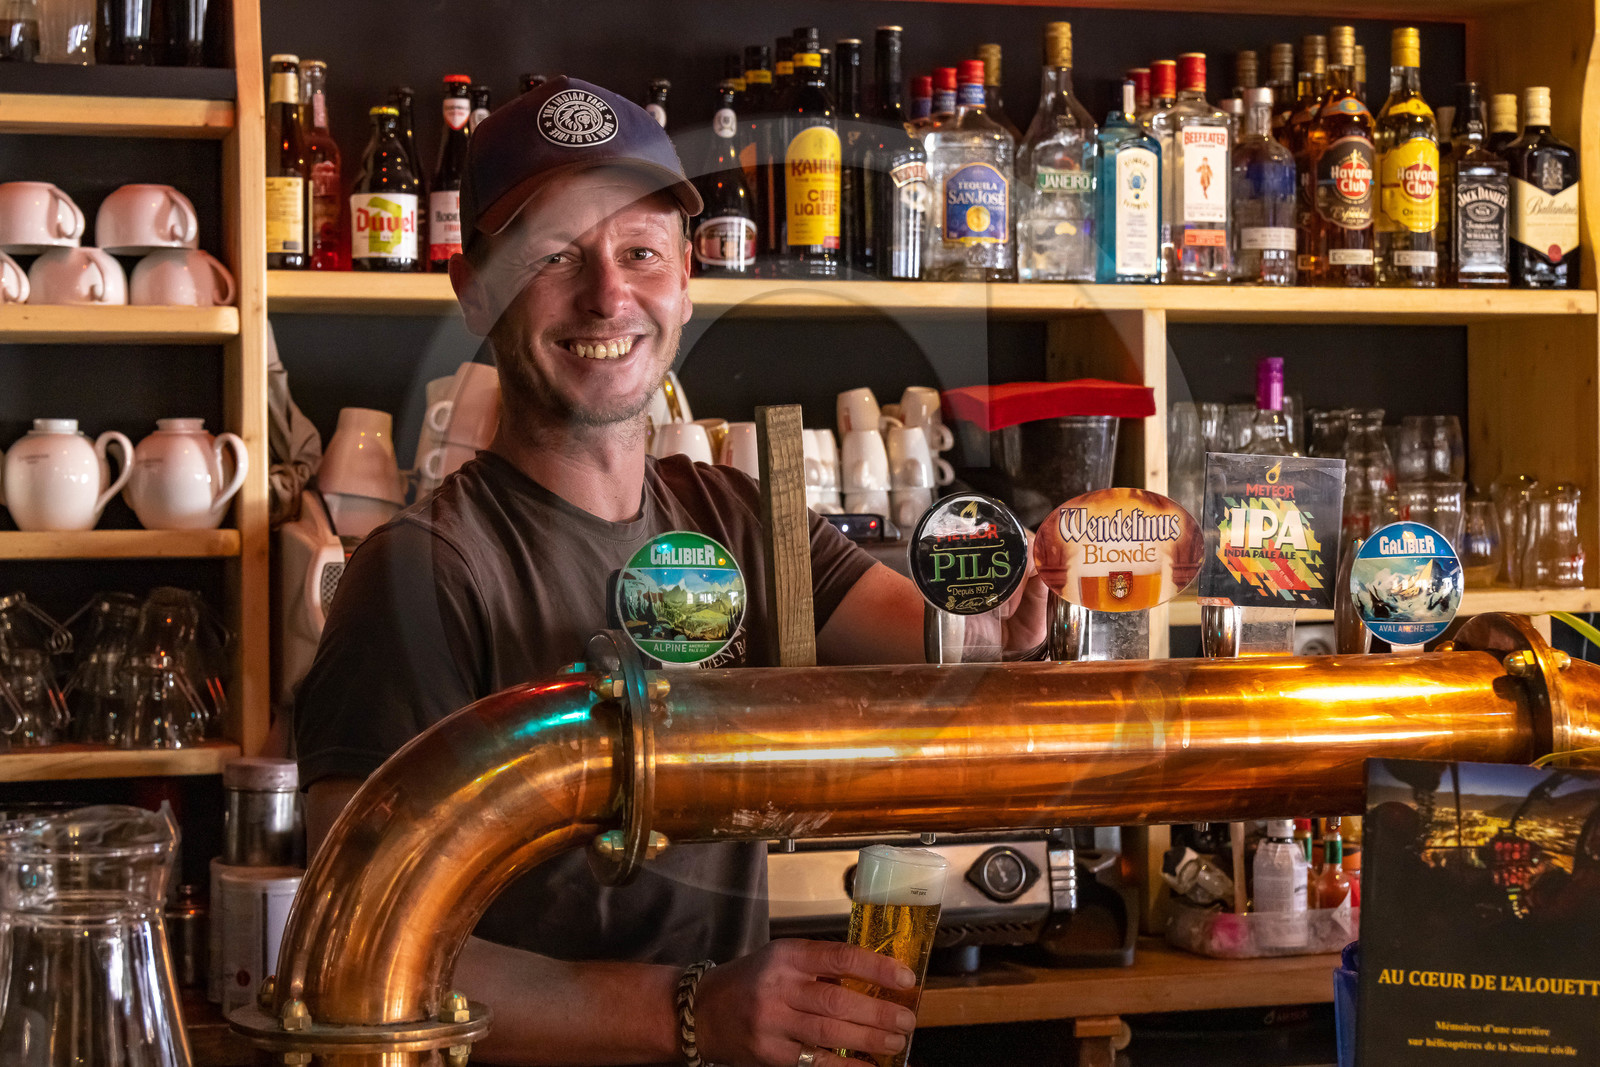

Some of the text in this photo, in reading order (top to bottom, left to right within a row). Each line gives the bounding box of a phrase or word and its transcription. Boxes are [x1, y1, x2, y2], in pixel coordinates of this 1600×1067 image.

[543, 92, 608, 118] THE INDIAN FACE
[548, 121, 615, 143] BORN TO BE FREE
[1184, 131, 1226, 146] BEEFEATER
[958, 181, 998, 190] TEQUILA
[1040, 173, 1090, 190] JANEIRO
[1340, 179, 1367, 193] Club
[1406, 181, 1432, 195] Club
[1457, 190, 1478, 208] JACK
[357, 207, 414, 233] Duvel
[1246, 483, 1295, 499] METEOR
[1059, 507, 1182, 544] Wendelinus
[1230, 508, 1309, 551] IPA
[1379, 534, 1436, 555] GALIBIER
[650, 543, 716, 566] GALIBIER
[1224, 549, 1297, 560] INDIA PALE ALE
[929, 550, 1011, 582] PILS
[952, 586, 989, 598] Depuis 1927
[1379, 624, 1425, 633] AVALANCHE
[653, 642, 688, 653] ALPINE
[1378, 968, 1405, 985] AU
[1408, 969, 1466, 989] CŒUR
[1470, 974, 1497, 991] DE
[1435, 1020, 1550, 1037] Mémoires d'une carrière
[1408, 1037, 1578, 1057] sur hélicoptères de la Sécurité civile
